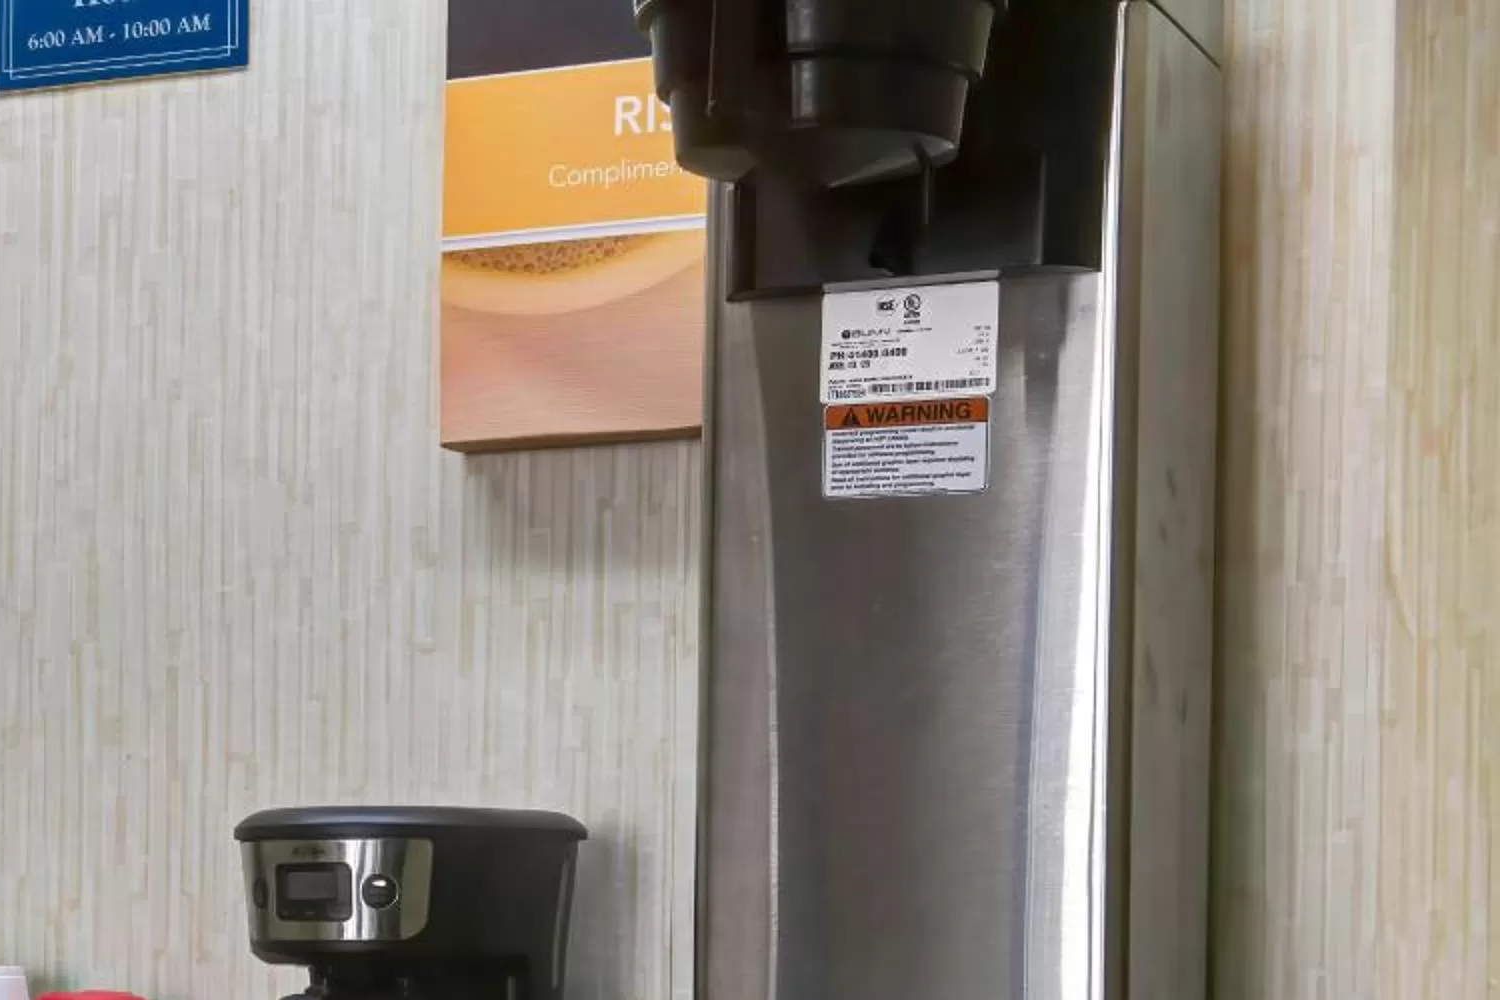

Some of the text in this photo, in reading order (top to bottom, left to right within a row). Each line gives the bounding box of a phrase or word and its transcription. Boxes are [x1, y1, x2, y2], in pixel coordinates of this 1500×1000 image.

[27, 29, 65, 50] 6:00
[71, 26, 104, 46] AM
[122, 18, 171, 41] 10:00
[176, 13, 212, 33] AM
[866, 401, 972, 424] WARNING
